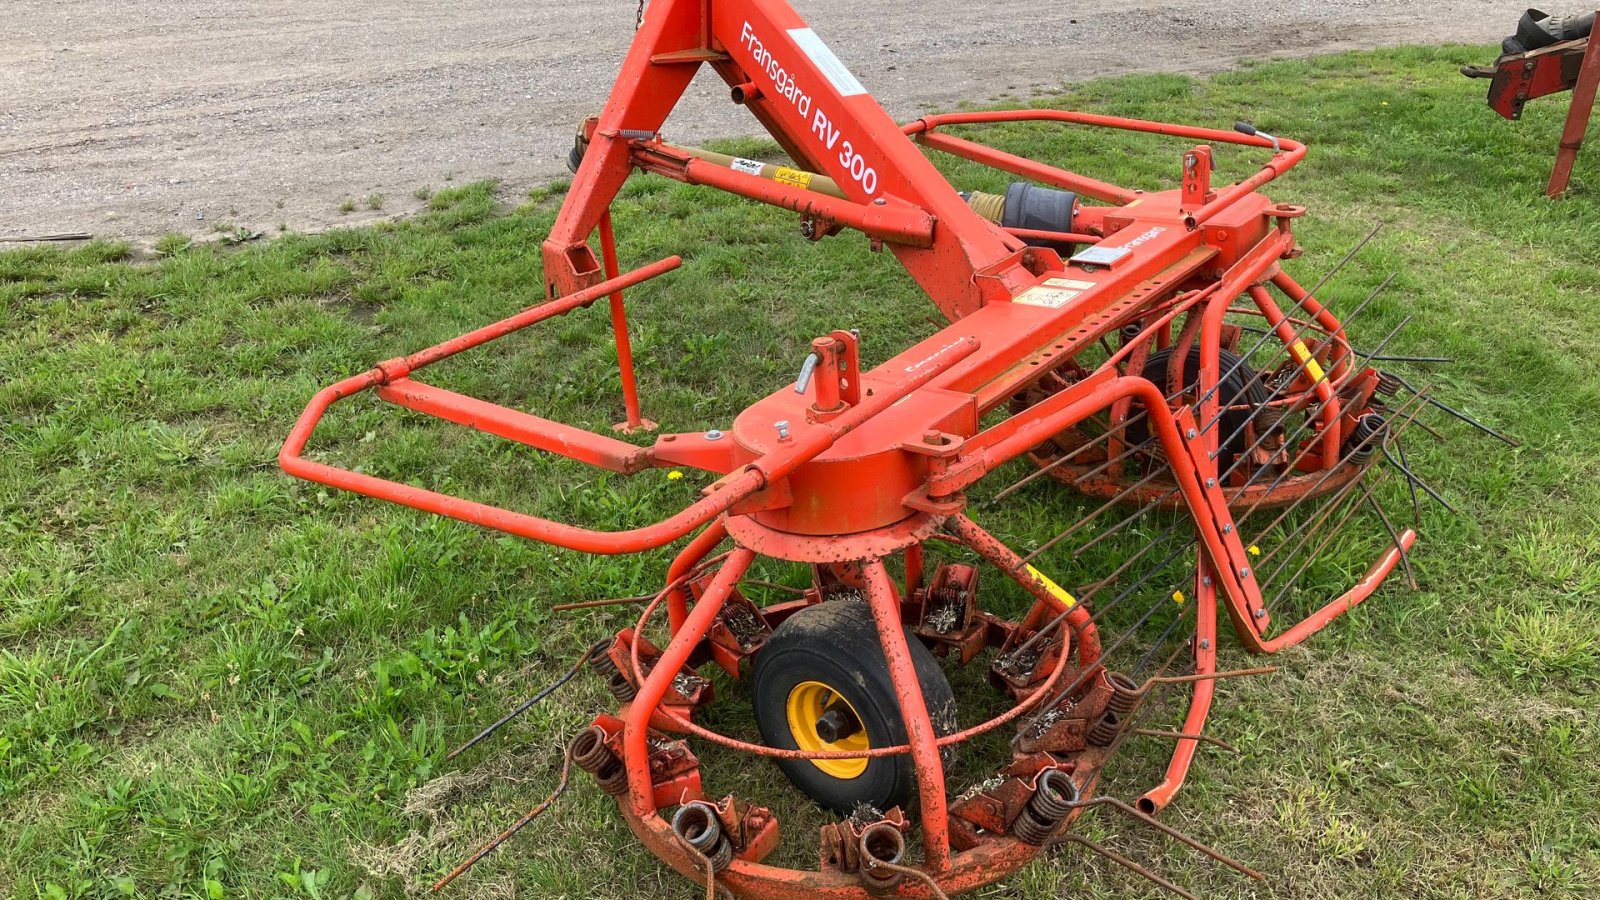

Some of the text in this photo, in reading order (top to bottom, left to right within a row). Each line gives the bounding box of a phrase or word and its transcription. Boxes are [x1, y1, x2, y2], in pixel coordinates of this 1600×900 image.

[740, 21, 811, 118] Fransgård
[811, 108, 840, 150] RV
[839, 141, 877, 194] 300
